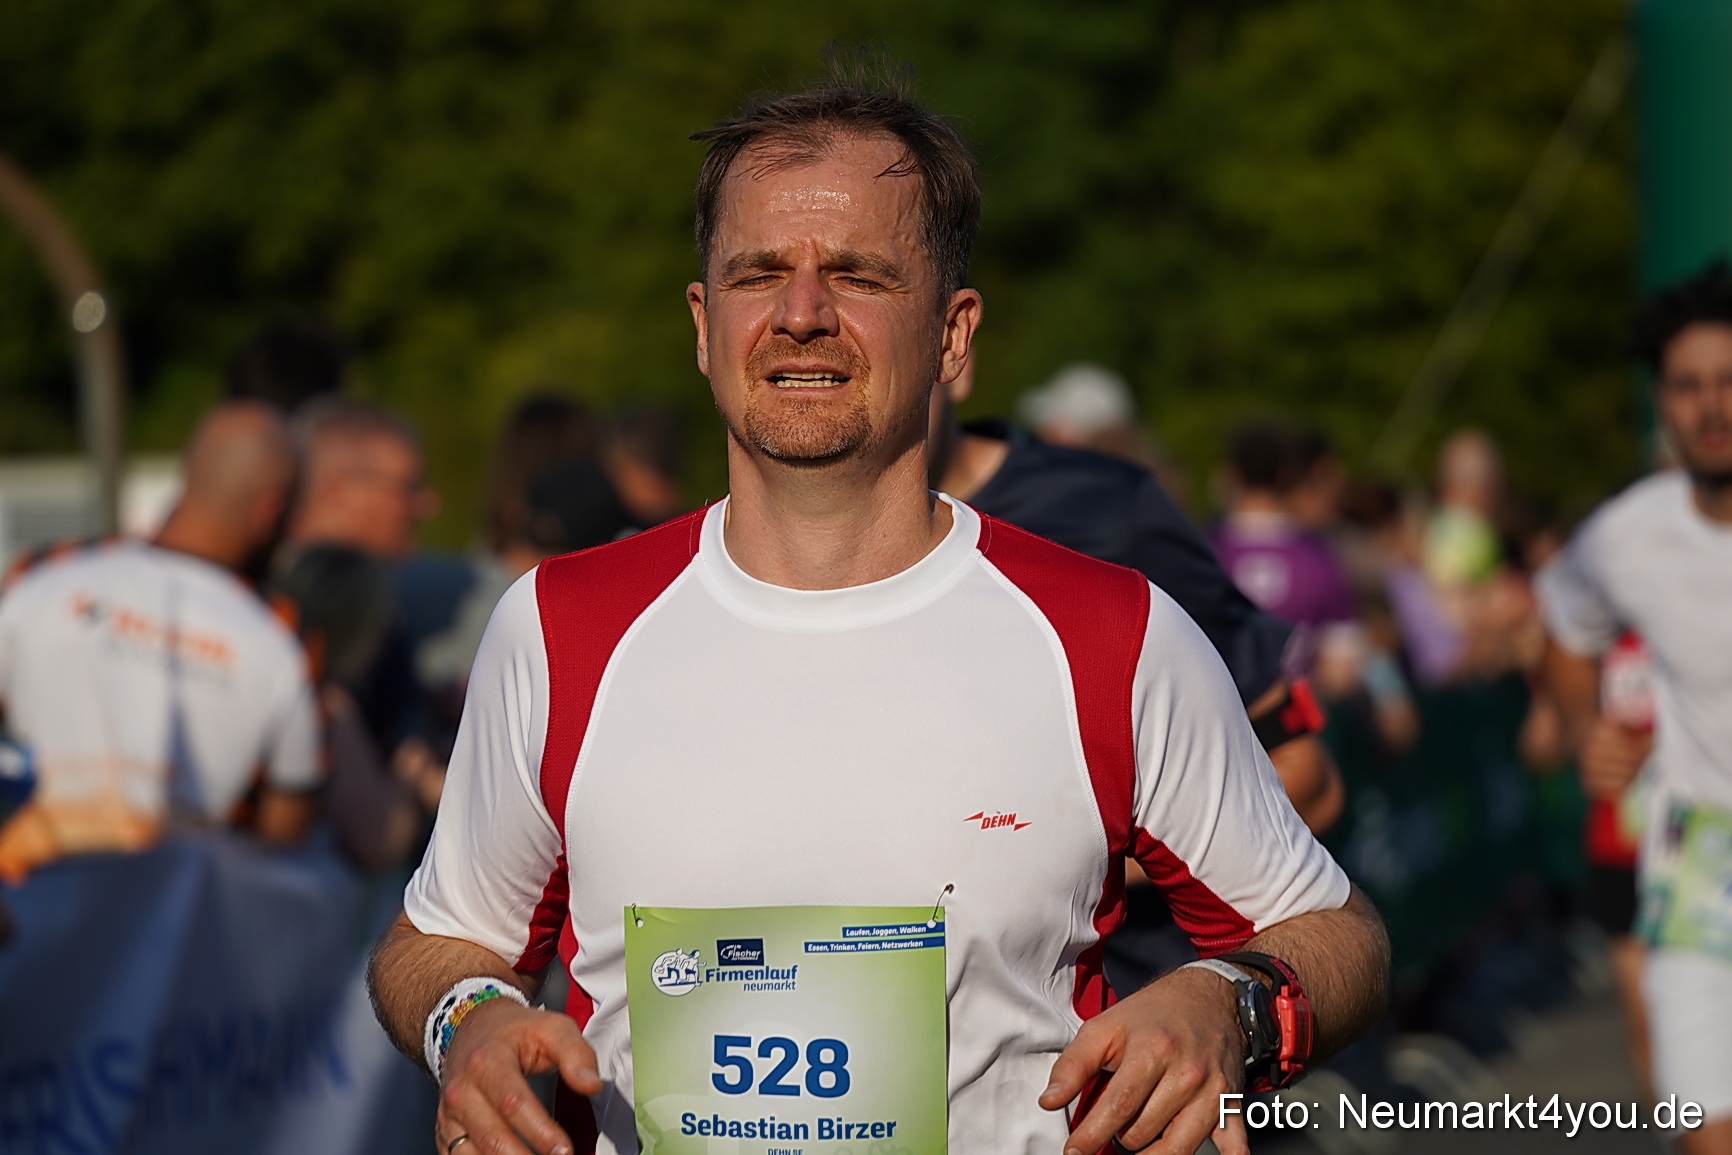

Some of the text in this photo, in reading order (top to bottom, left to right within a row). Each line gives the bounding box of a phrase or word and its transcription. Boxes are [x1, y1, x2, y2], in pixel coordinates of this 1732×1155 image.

[981, 813, 1017, 830] DEHN
[846, 925, 927, 937] Laufen, Joggen, Walken
[727, 945, 761, 959] Fischer
[808, 940, 924, 952] Essen, Trinken, Feiern, Netzwerken
[705, 964, 799, 983] Firmenlauf
[743, 980, 796, 992] neumarkt
[711, 1034, 851, 1099] 528
[680, 1112, 897, 1140] Sebastian Birzer
